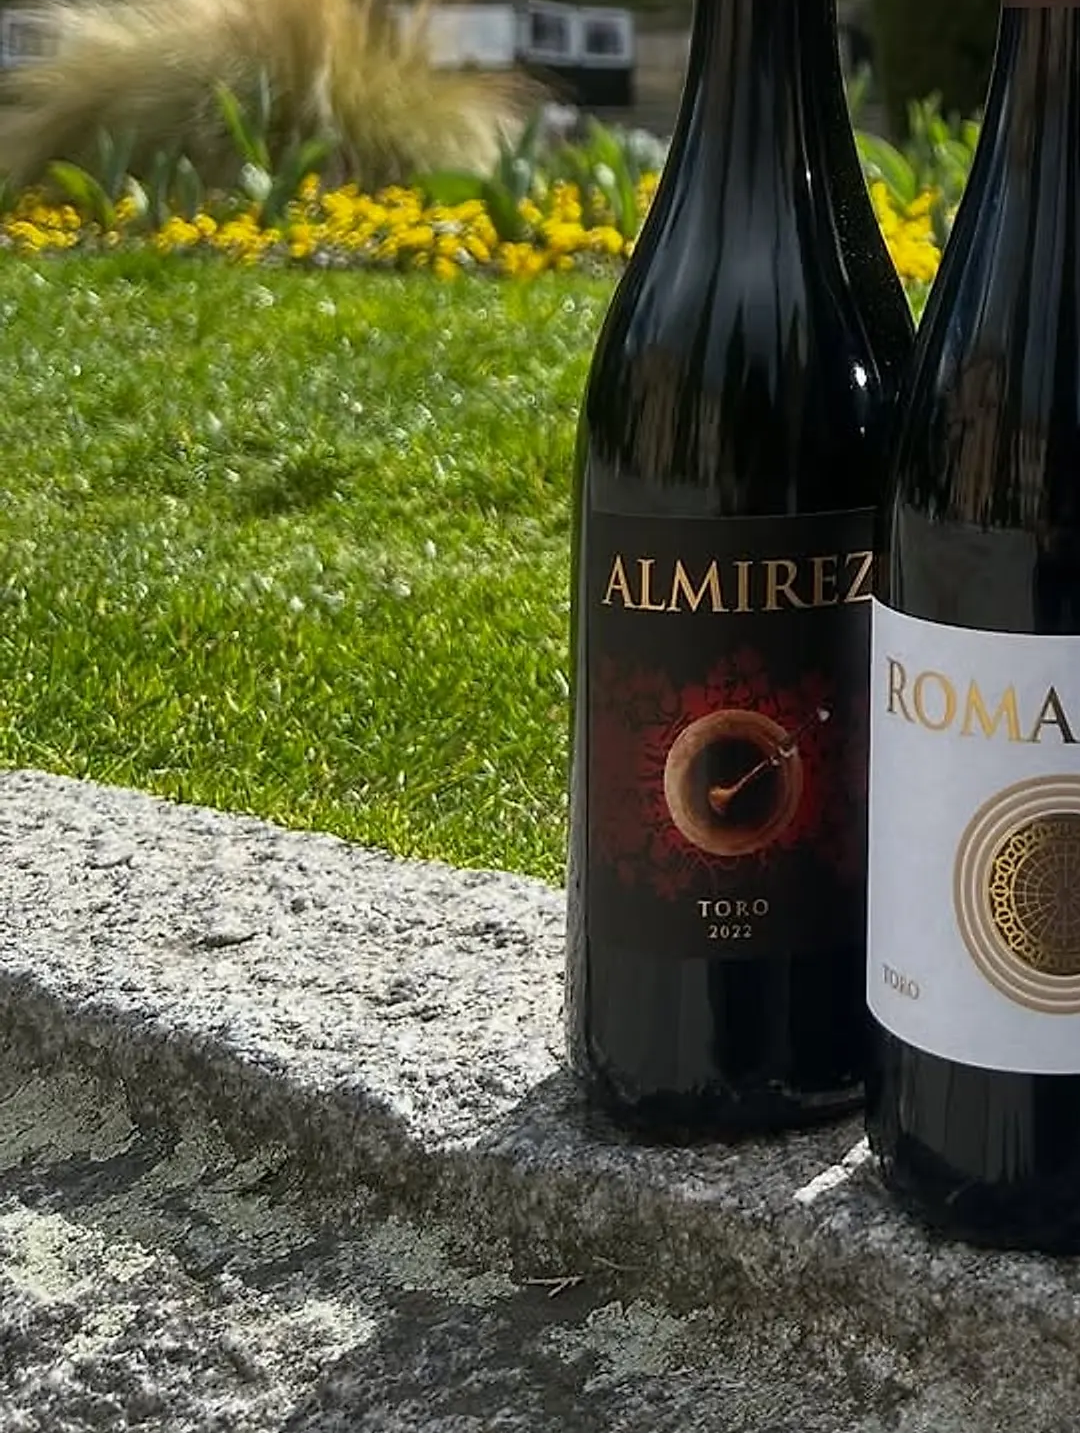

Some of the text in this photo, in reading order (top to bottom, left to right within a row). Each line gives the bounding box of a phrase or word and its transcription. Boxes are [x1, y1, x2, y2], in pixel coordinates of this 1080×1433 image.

[600, 550, 874, 613] ALMIREZ
[697, 898, 769, 918] TORO
[708, 924, 753, 939] 2022
[881, 962, 920, 1001] TORO
